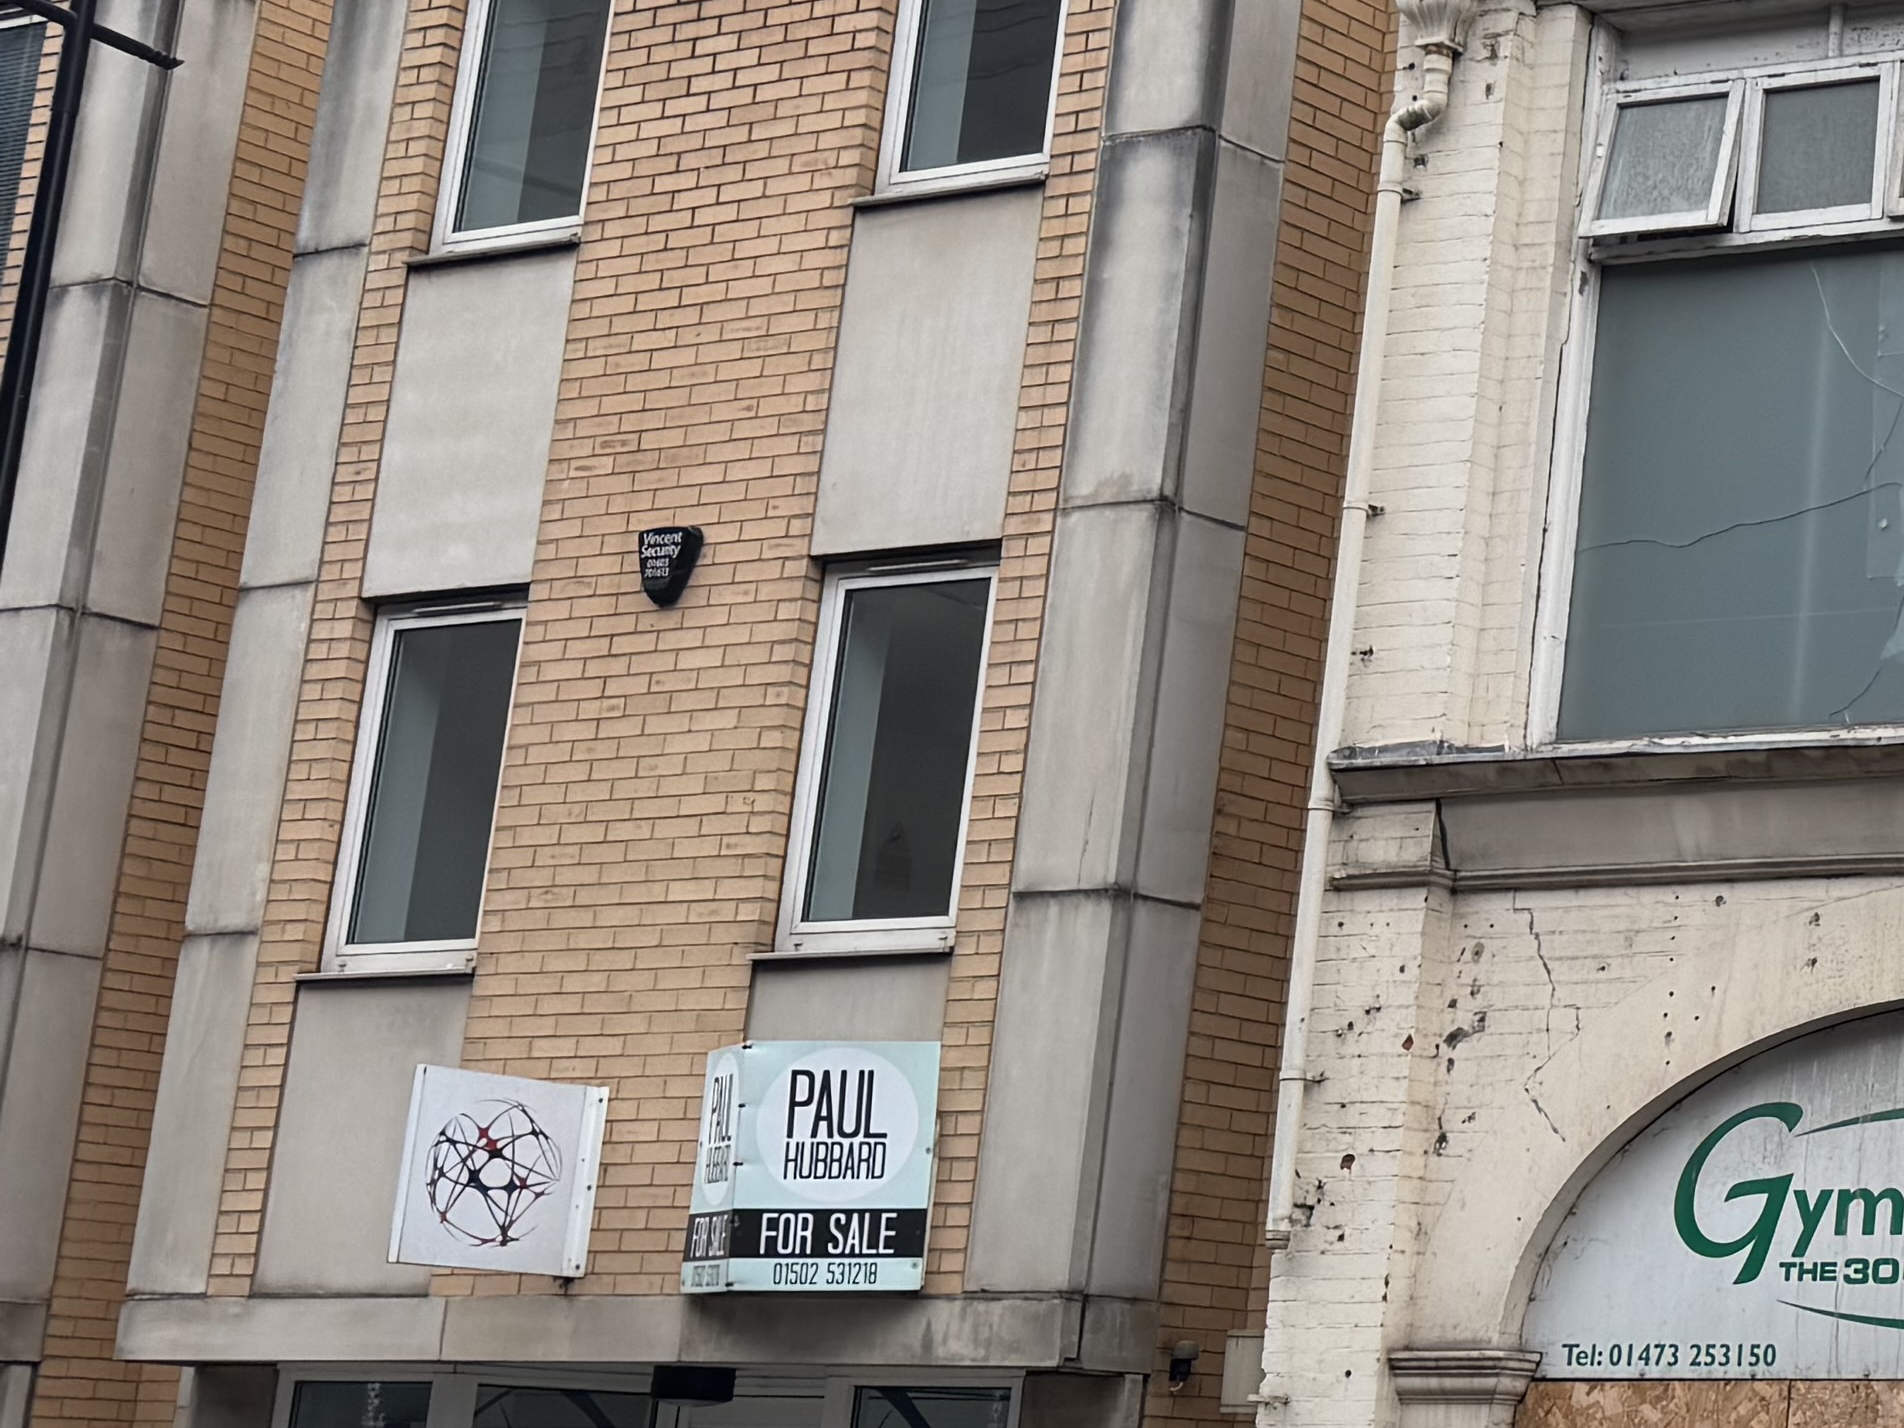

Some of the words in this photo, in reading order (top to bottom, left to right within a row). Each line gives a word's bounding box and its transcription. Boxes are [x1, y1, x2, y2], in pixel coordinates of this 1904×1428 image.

[643, 531, 683, 545] Vincent
[641, 544, 681, 559] Security
[786, 1069, 888, 1139] PAUL
[783, 1141, 887, 1180] HUBBARD
[759, 1212, 814, 1255] FOR
[827, 1212, 898, 1255] SALE
[773, 1262, 819, 1285] 01502
[826, 1262, 878, 1285] 531218
[1779, 1261, 1838, 1283] THE
[1562, 1343, 1603, 1366] Tel:
[1609, 1343, 1680, 1367] 01473
[1689, 1343, 1776, 1367] 253150
